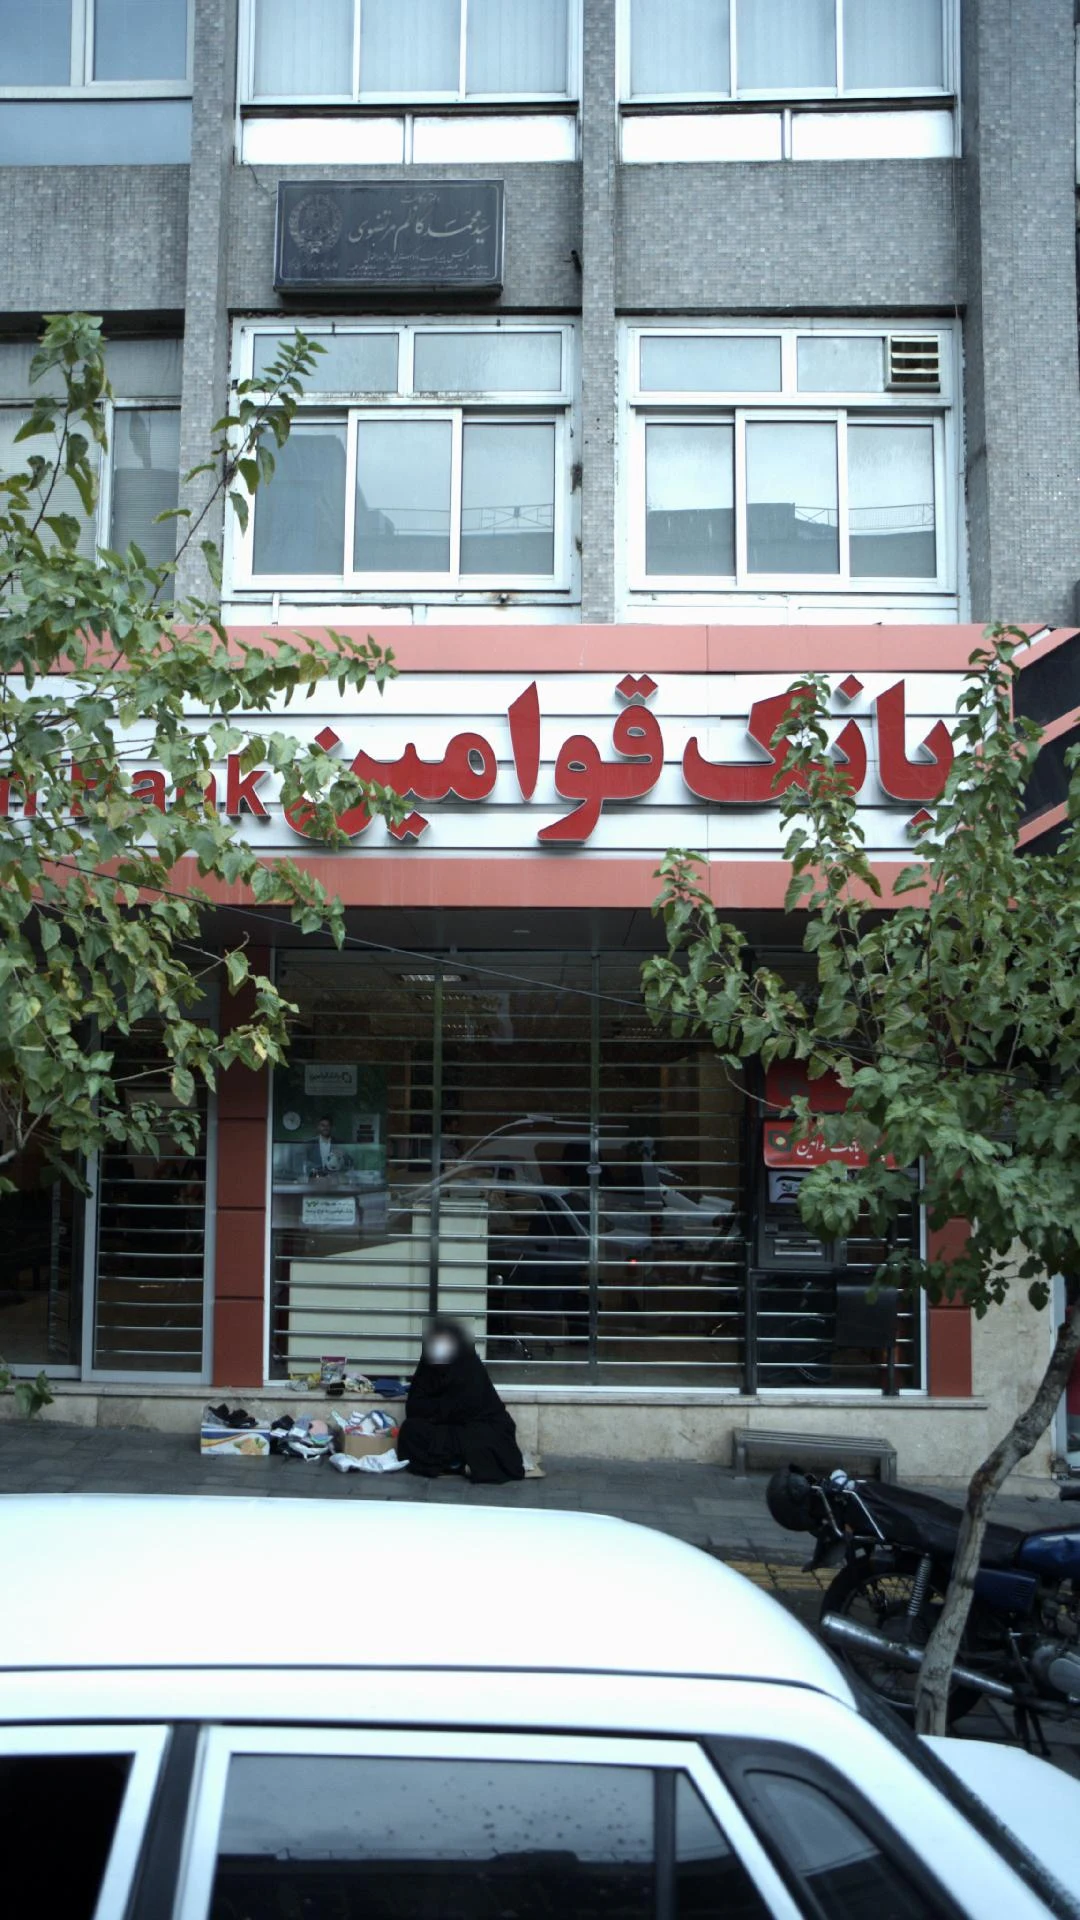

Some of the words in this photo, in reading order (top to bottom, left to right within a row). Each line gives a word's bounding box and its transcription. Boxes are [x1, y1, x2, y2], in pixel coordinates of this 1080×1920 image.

[284, 672, 664, 842] قوامین
[683, 673, 956, 838] بانک
[796, 1139, 826, 1159] وامین
